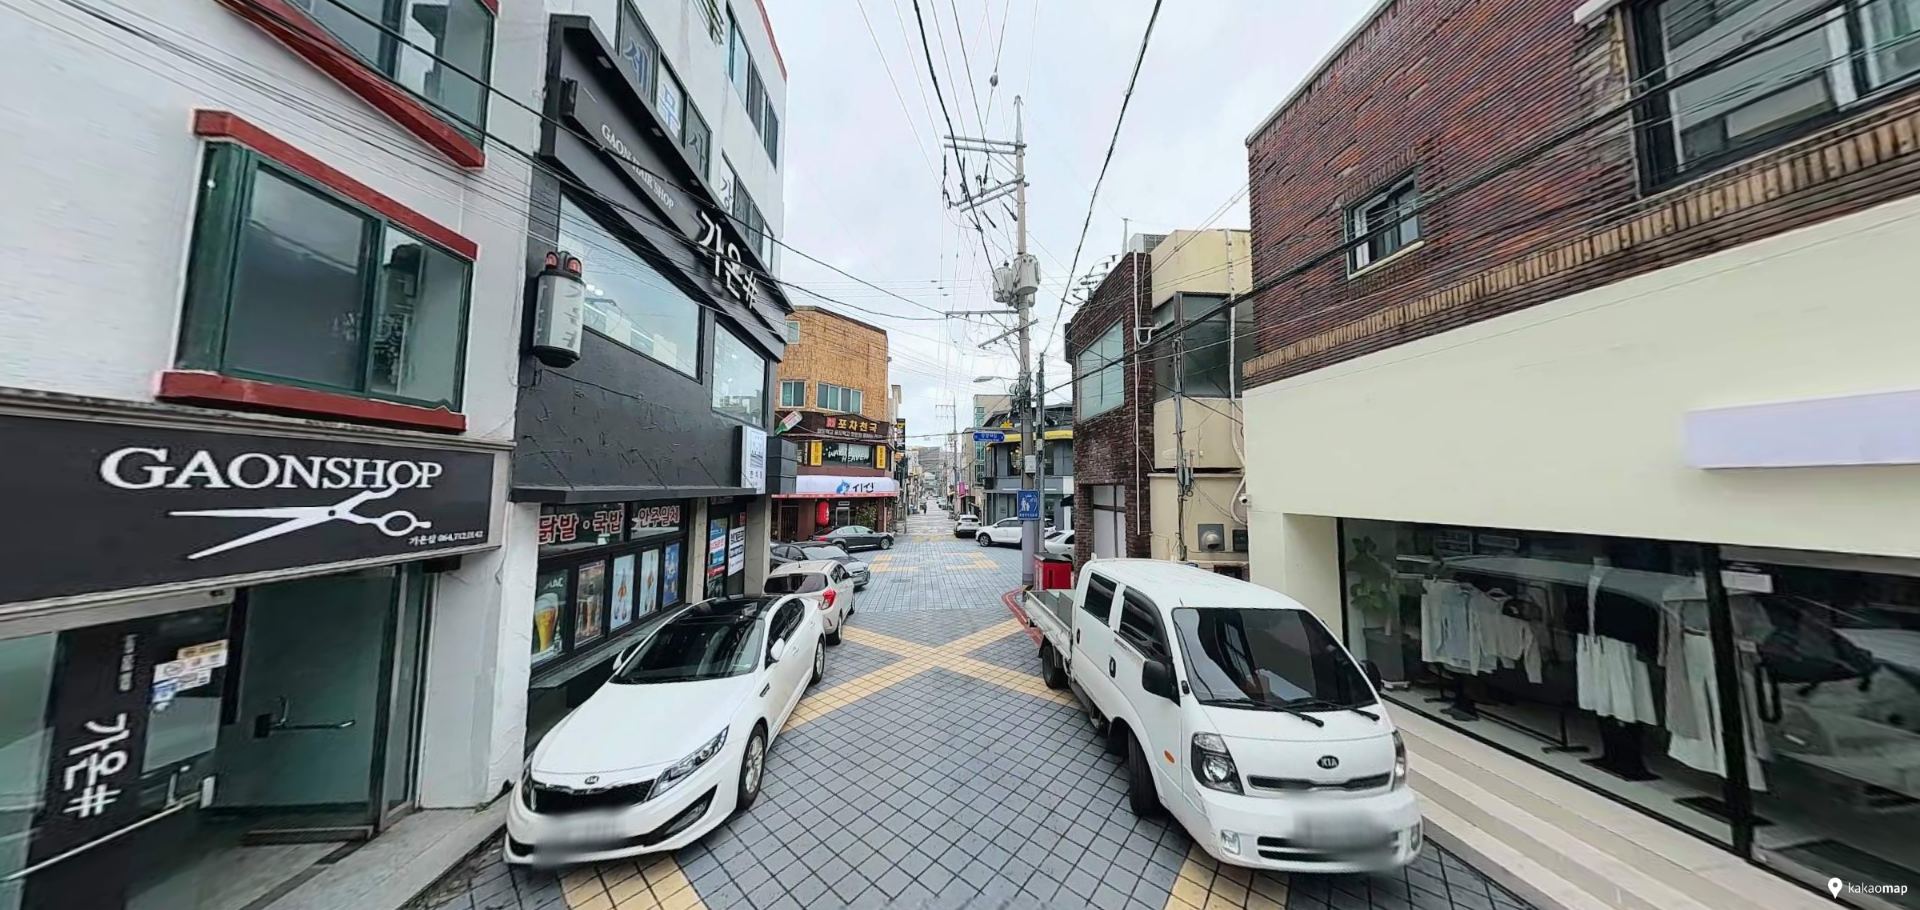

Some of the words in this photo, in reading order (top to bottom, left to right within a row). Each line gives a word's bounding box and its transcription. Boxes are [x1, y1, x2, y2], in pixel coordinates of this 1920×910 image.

[601, 124, 632, 160] GAON
[631, 156, 653, 189] HAIR
[653, 180, 674, 210] SHOP
[837, 418, 878, 433] 포차천국
[828, 449, 843, 459] WAY
[841, 453, 870, 463] HEAVEN
[100, 447, 443, 490] GAONSHOP
[592, 509, 624, 535] 국밥
